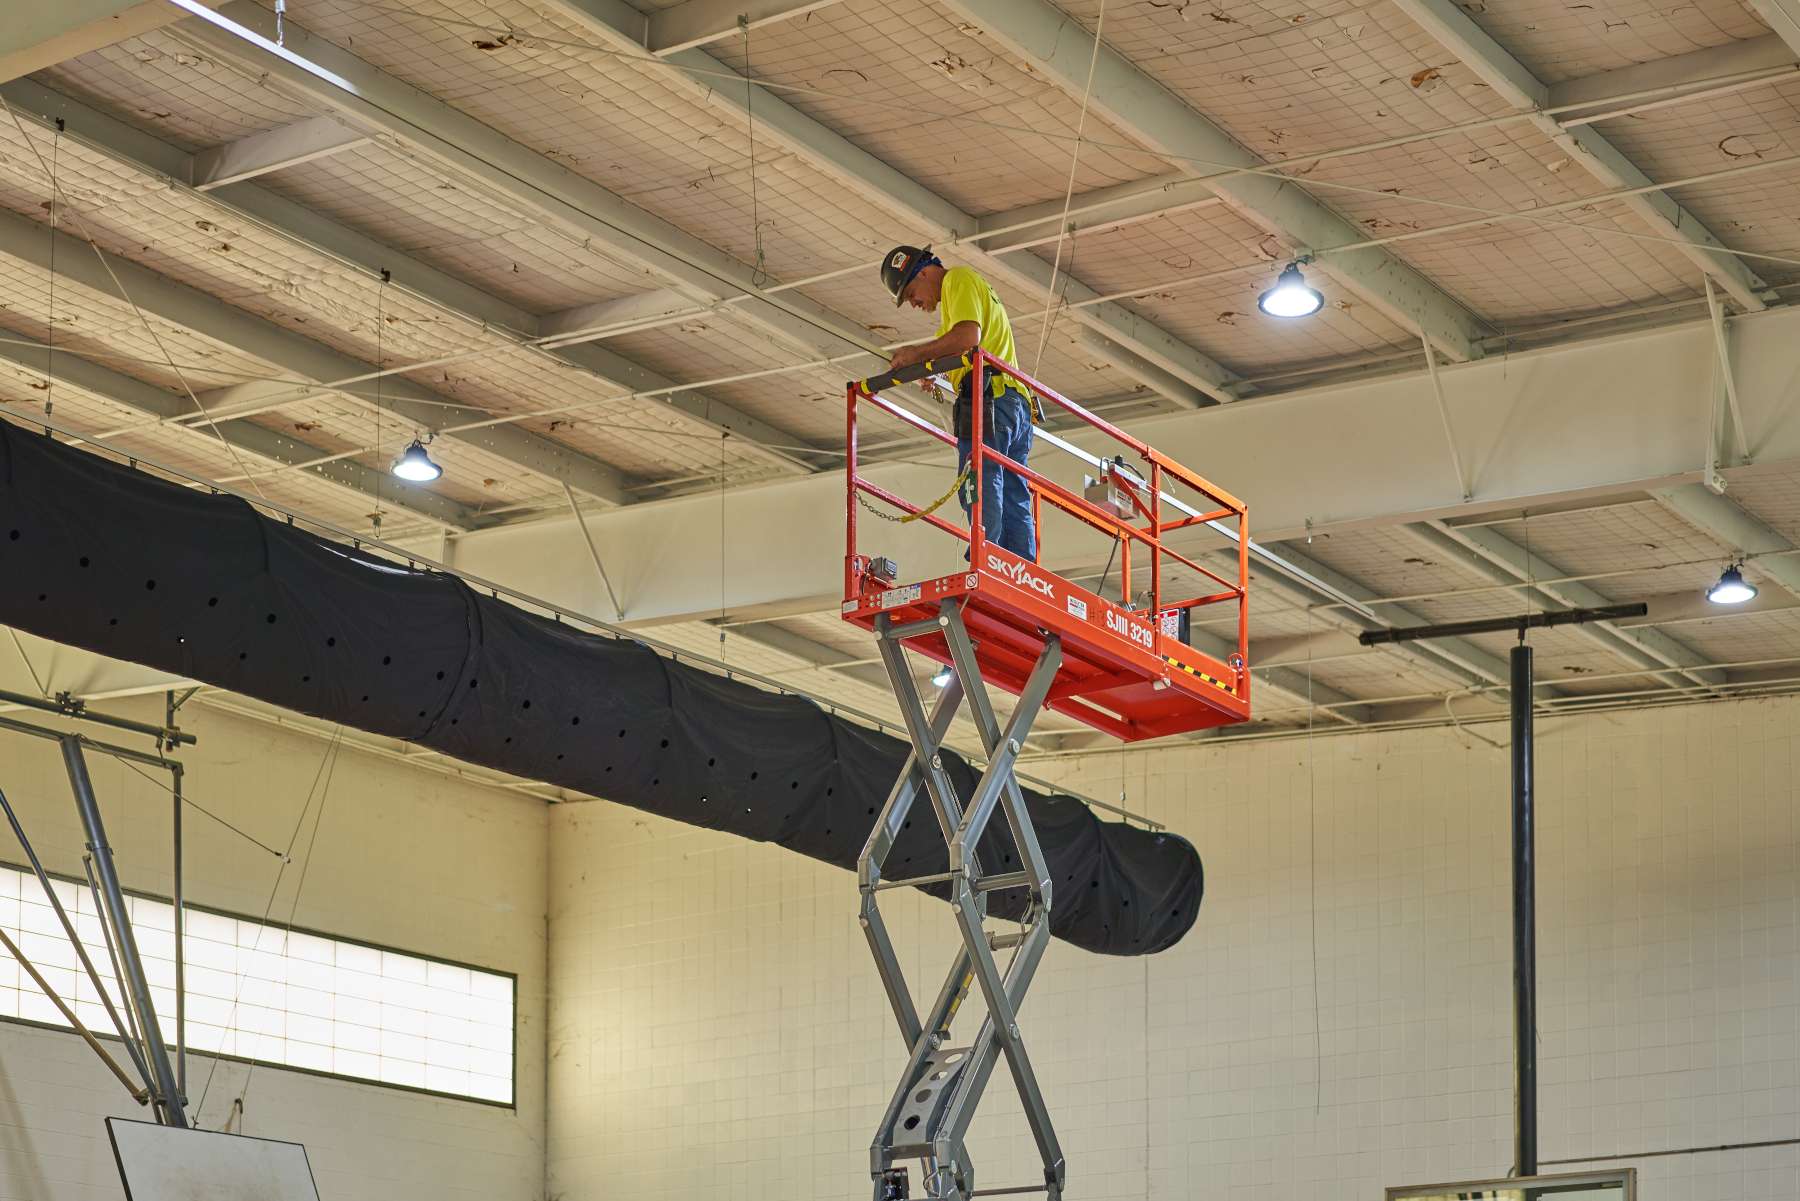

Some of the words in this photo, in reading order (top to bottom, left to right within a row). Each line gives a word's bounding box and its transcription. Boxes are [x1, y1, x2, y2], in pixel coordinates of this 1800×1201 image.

[987, 554, 1055, 599] SKYJACK
[1106, 609, 1128, 637] SJIII
[1130, 622, 1153, 648] 3219
